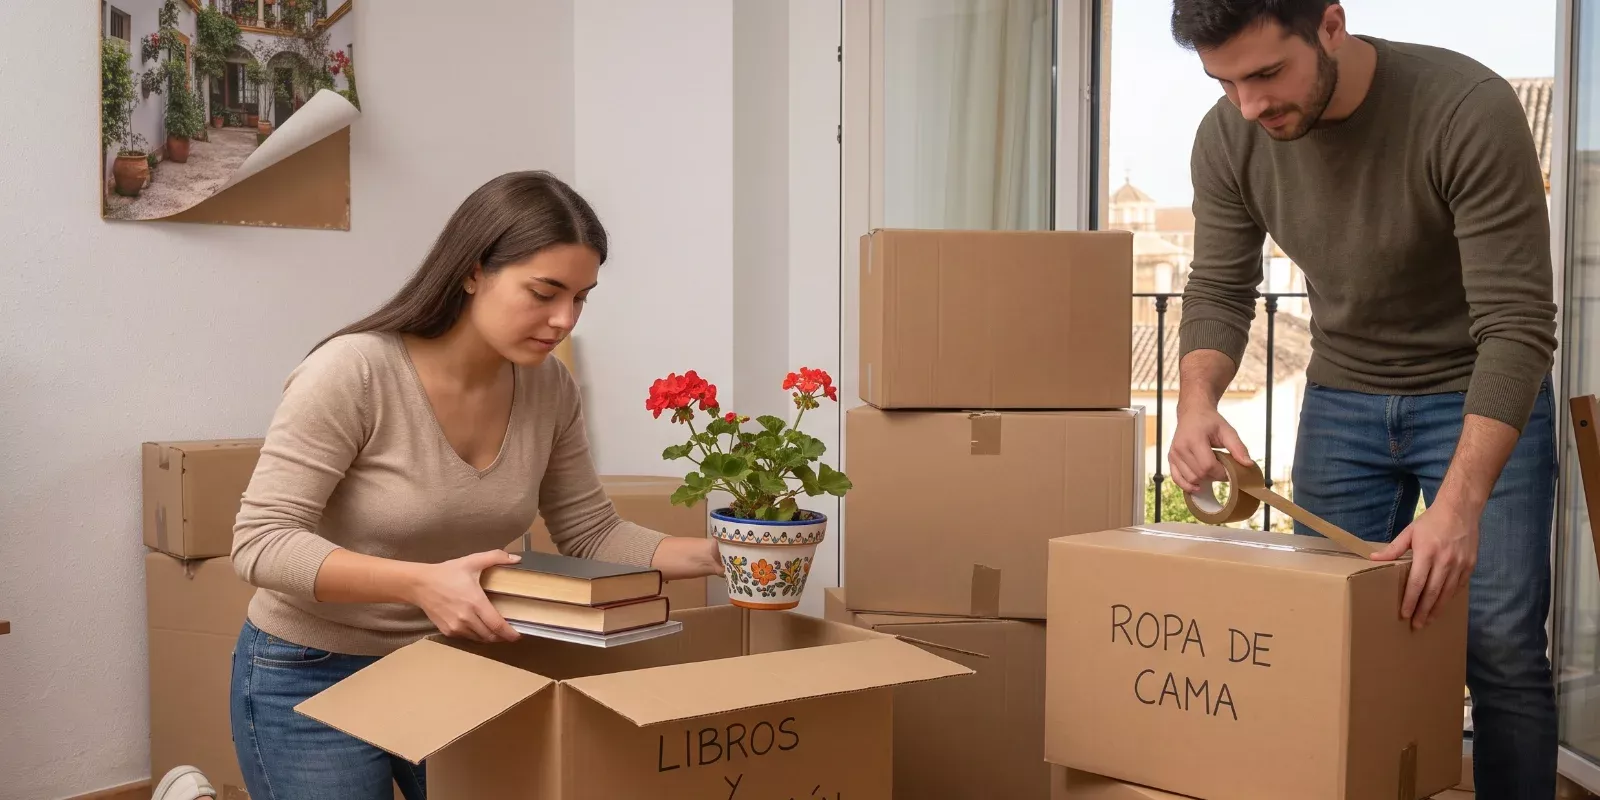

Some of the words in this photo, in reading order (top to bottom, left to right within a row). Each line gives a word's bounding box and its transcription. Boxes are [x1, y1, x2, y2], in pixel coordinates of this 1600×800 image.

[1111, 604, 1206, 658] ROPA
[1228, 628, 1274, 668] DE
[1134, 668, 1238, 721] CAMA
[658, 716, 800, 773] LIBROS
